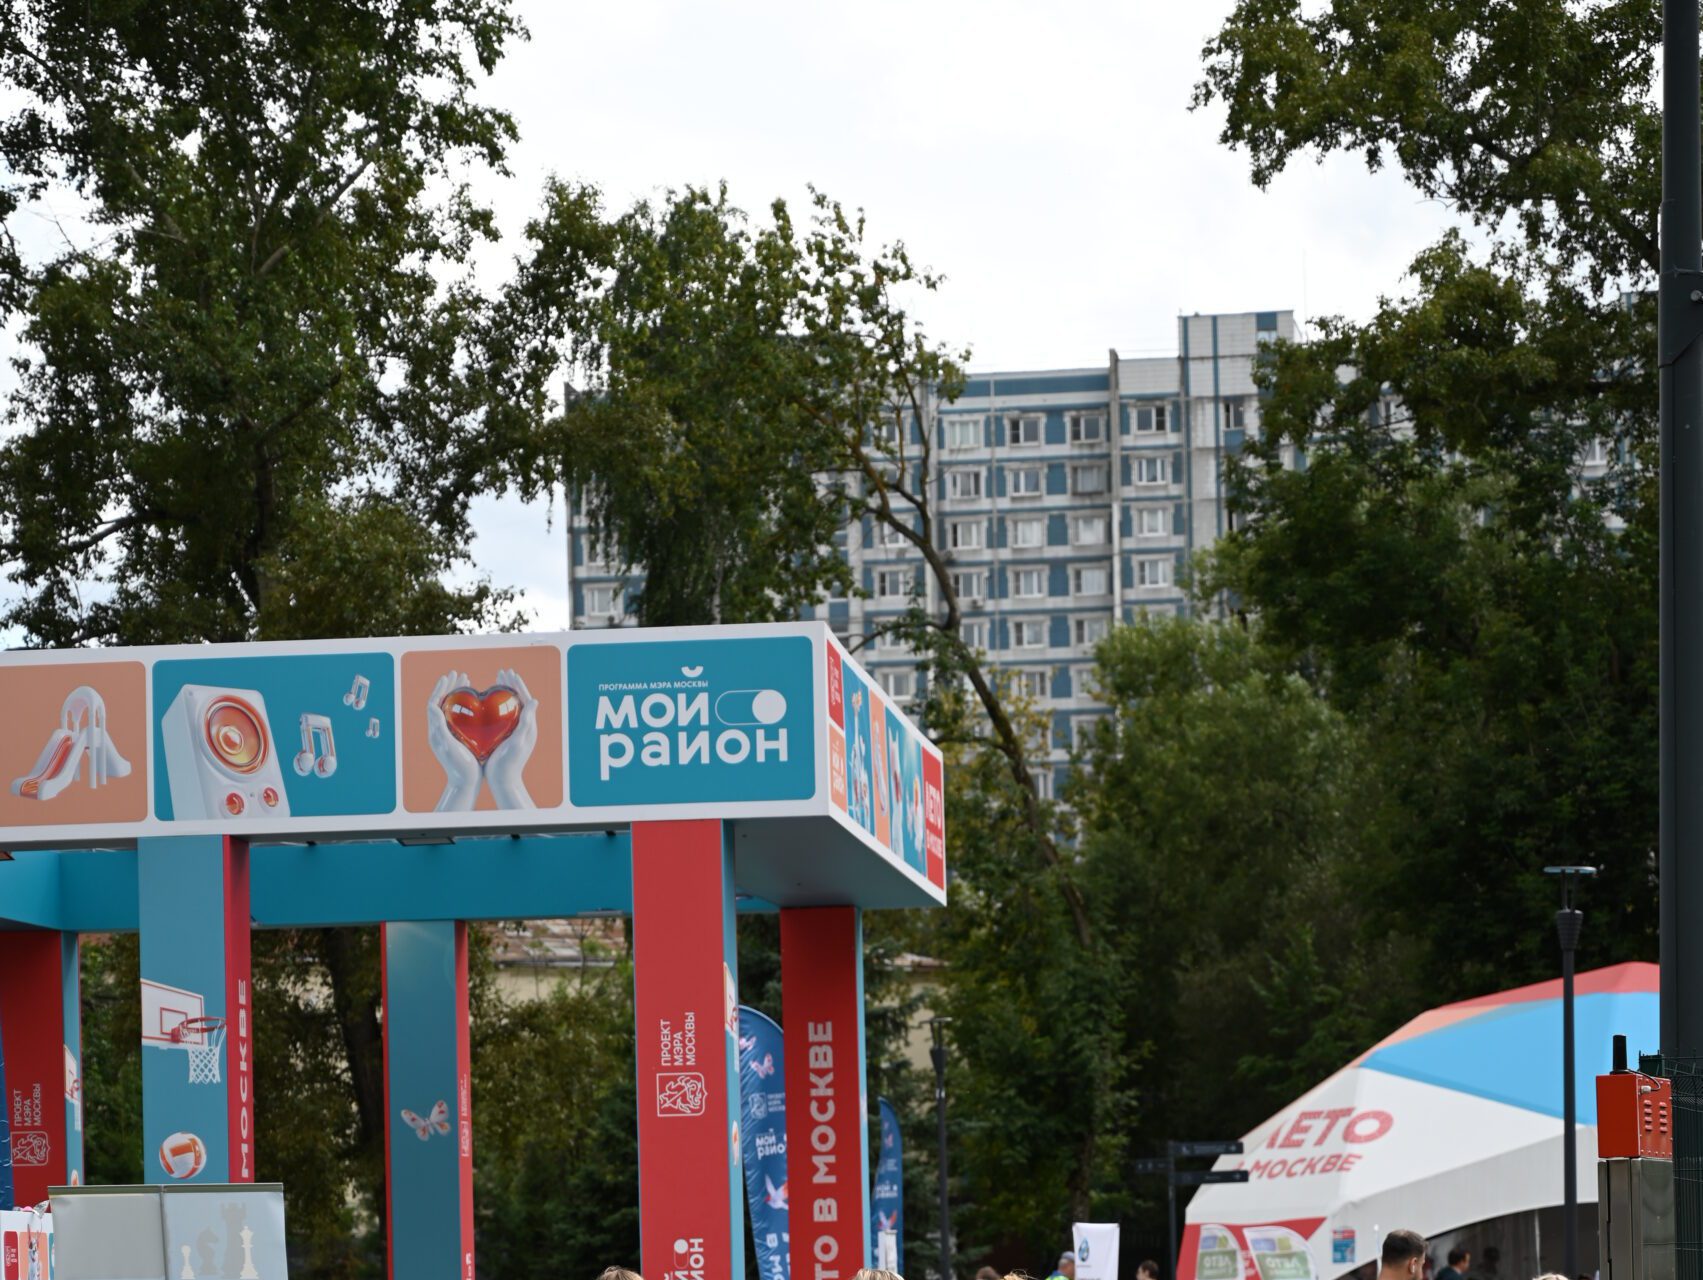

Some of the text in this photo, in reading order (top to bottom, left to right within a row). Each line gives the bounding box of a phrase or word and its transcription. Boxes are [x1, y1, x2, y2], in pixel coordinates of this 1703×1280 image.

[598, 680, 709, 691] ПРОГРАММА МЭРА МОСКВЫ
[660, 1018, 672, 1066] ПРОЕКТ
[673, 1031, 684, 1066] МЭРА
[684, 1011, 696, 1066] МОСКВЫ
[238, 979, 249, 1178] МОСКВЕ
[808, 1021, 838, 1184] МОСКВЕ
[813, 1197, 839, 1222] В
